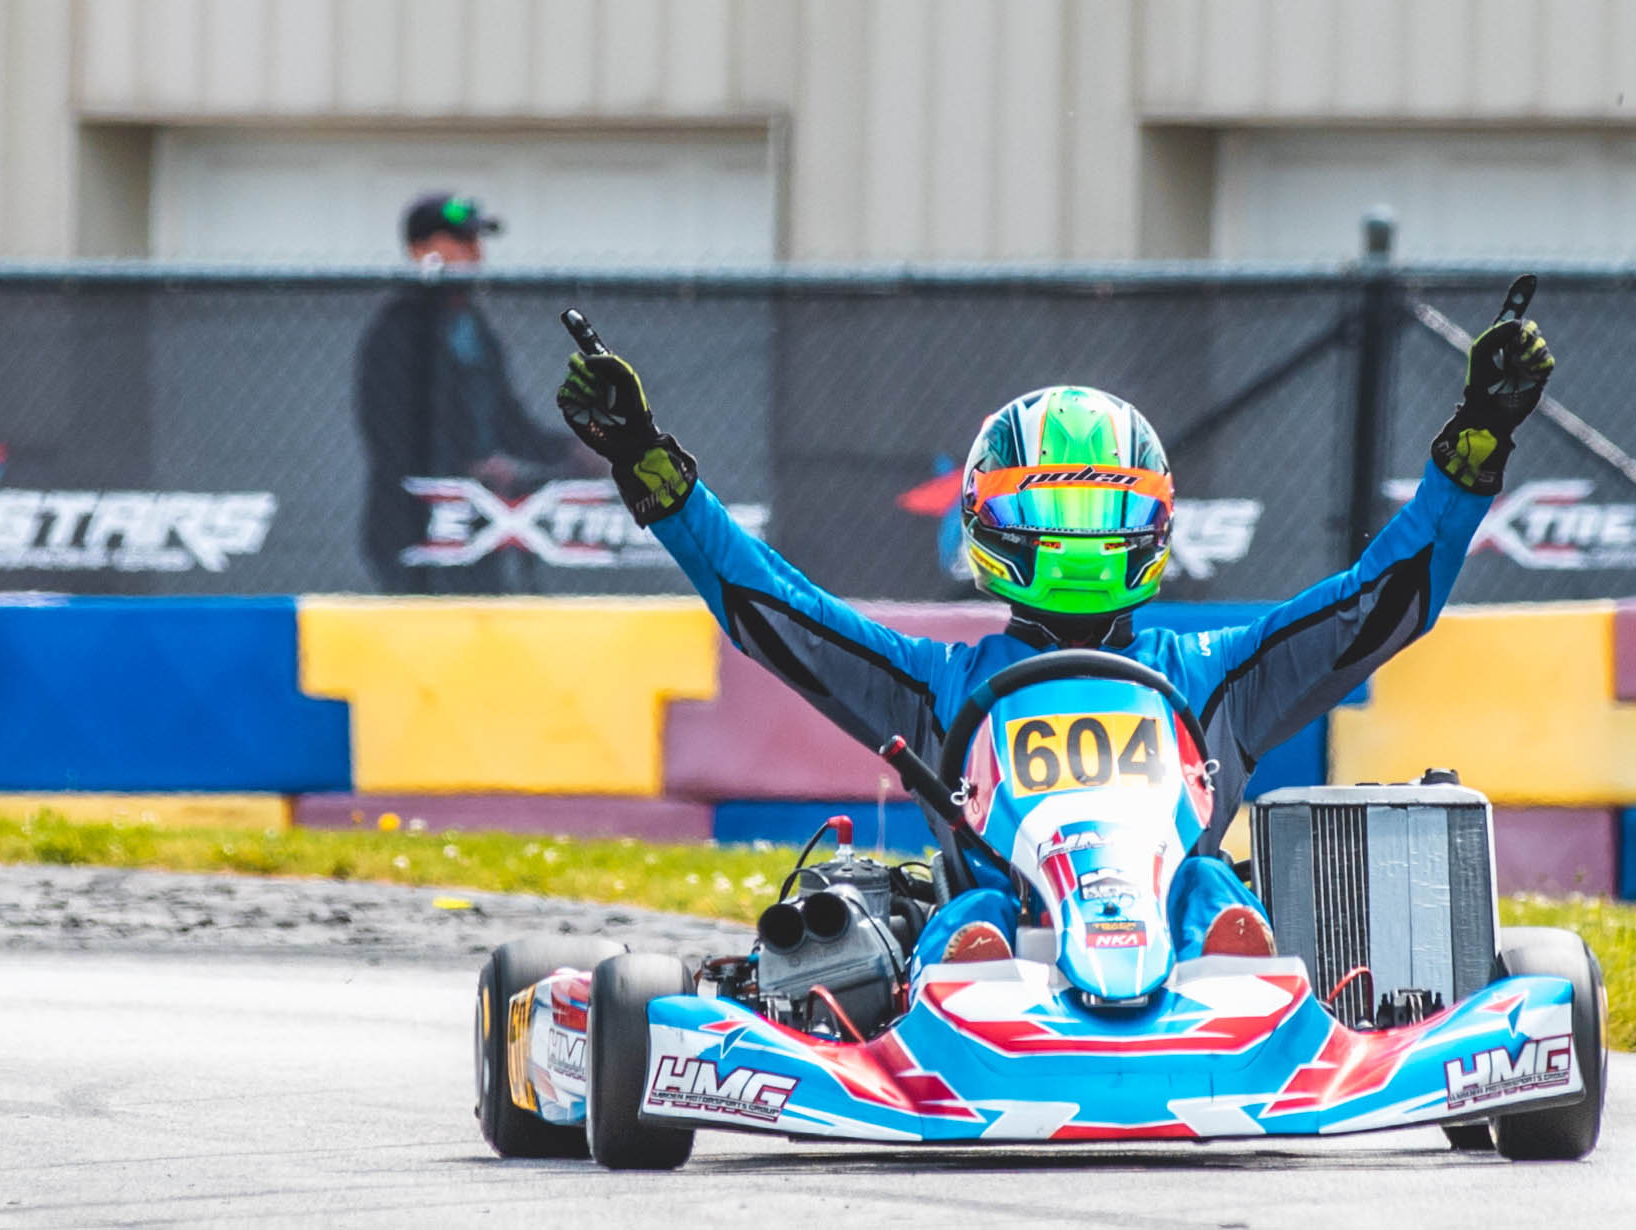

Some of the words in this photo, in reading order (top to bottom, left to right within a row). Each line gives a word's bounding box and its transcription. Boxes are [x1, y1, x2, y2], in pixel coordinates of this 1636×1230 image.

[1013, 717, 1165, 792] 604
[1095, 933, 1139, 946] NKA
[647, 1055, 802, 1123] HMG
[1444, 1032, 1573, 1110] HMG
